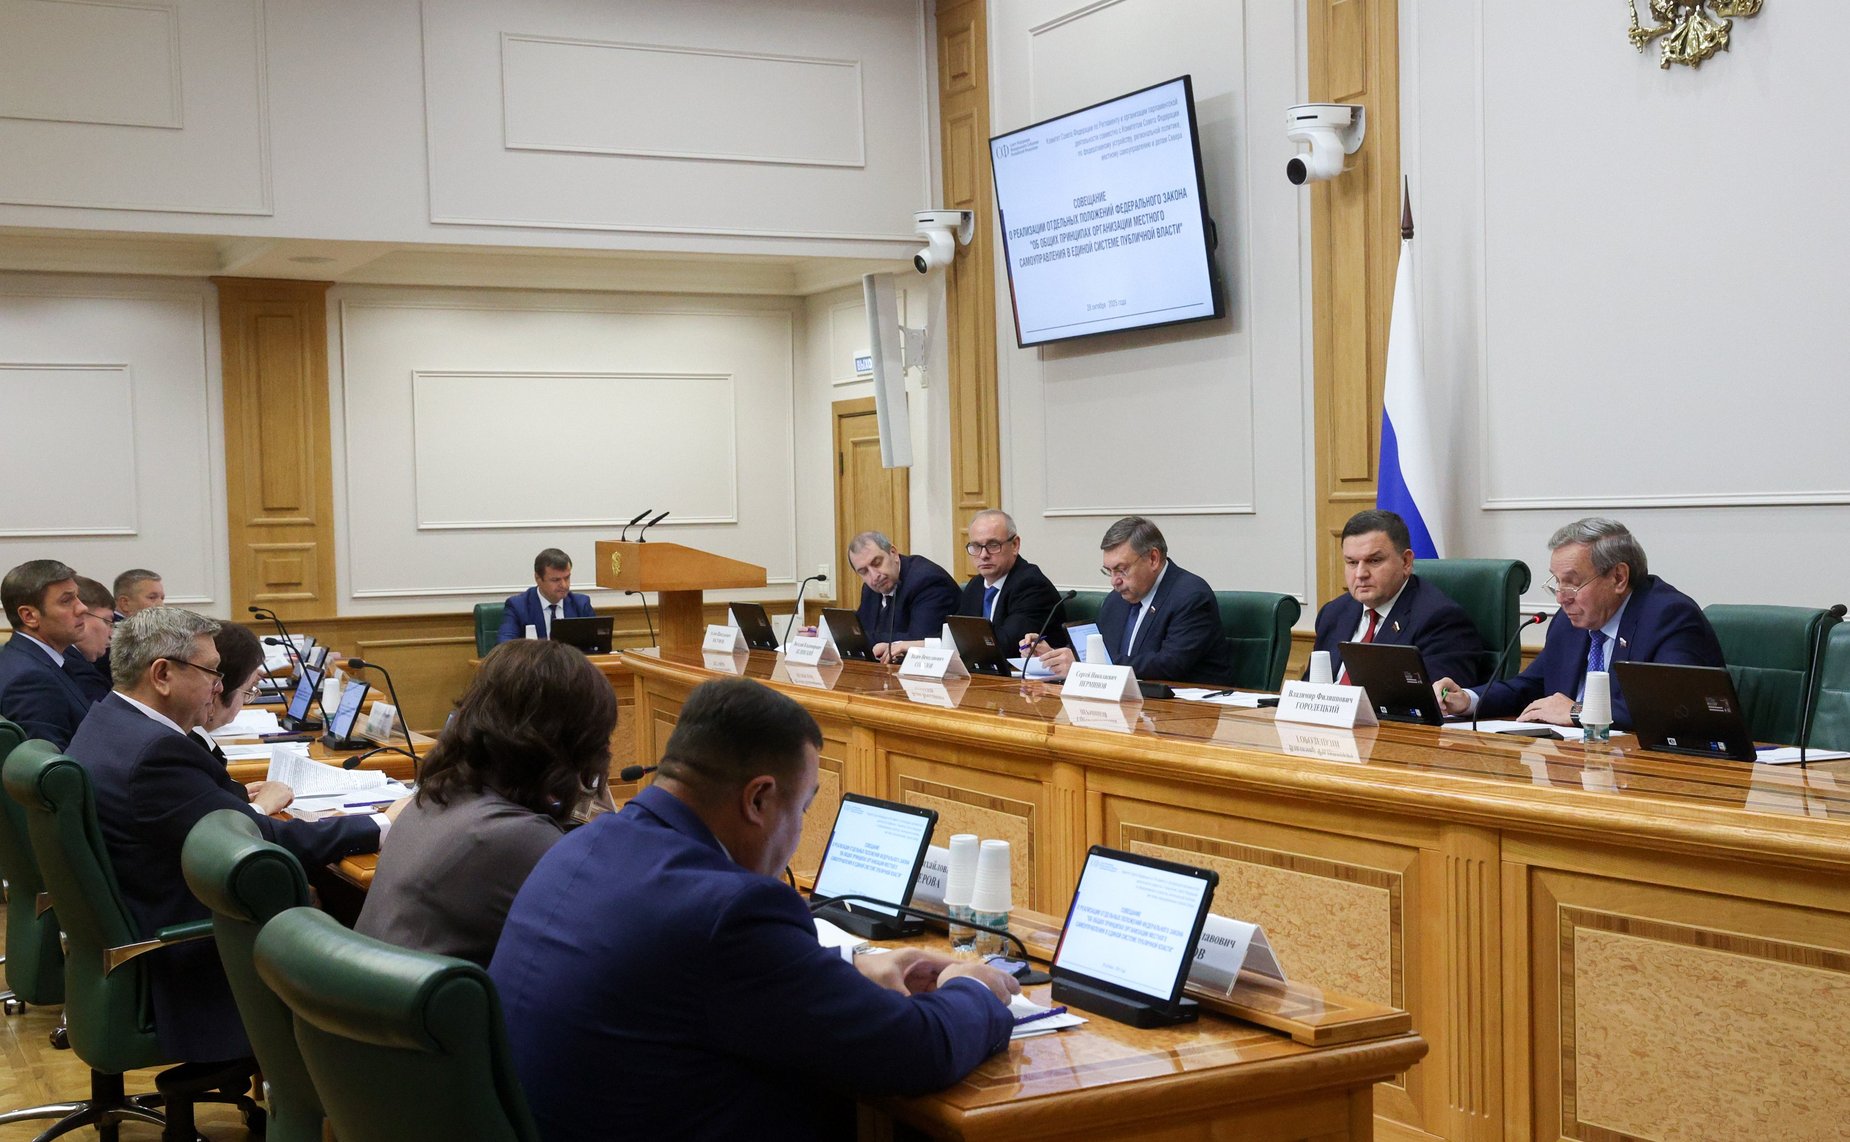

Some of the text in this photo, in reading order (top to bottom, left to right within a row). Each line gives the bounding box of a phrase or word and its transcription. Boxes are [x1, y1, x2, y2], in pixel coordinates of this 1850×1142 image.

[1073, 191, 1107, 208] СОВЕЩАНИЕ
[1008, 187, 1188, 241] О РЕАЛИЗАЦИИ ОТДЕЛЬНЫХ ПОЛОЖЕНИЙ ФЕДЕРАЛЬНОГО ЗАКОНА
[1040, 234, 1060, 248] ОБЩИХ
[1060, 227, 1091, 243] ПРИНЦИПАХ
[1092, 217, 1133, 236] ОРГАНИЗАЦИИ
[1133, 210, 1165, 226] МЕСТНОГО
[1019, 222, 1183, 268] САМОУПРАВЛЕНИЯ В ЕДИНОЙ СИСТЕМЕ ПУБЛИЧНОЙ ВЛАСТИ"
[1288, 689, 1354, 704] Владимир Филиппович
[1295, 701, 1340, 714] ГОРОДЕЦКИЙ
[918, 872, 940, 889] ЕРОВА
